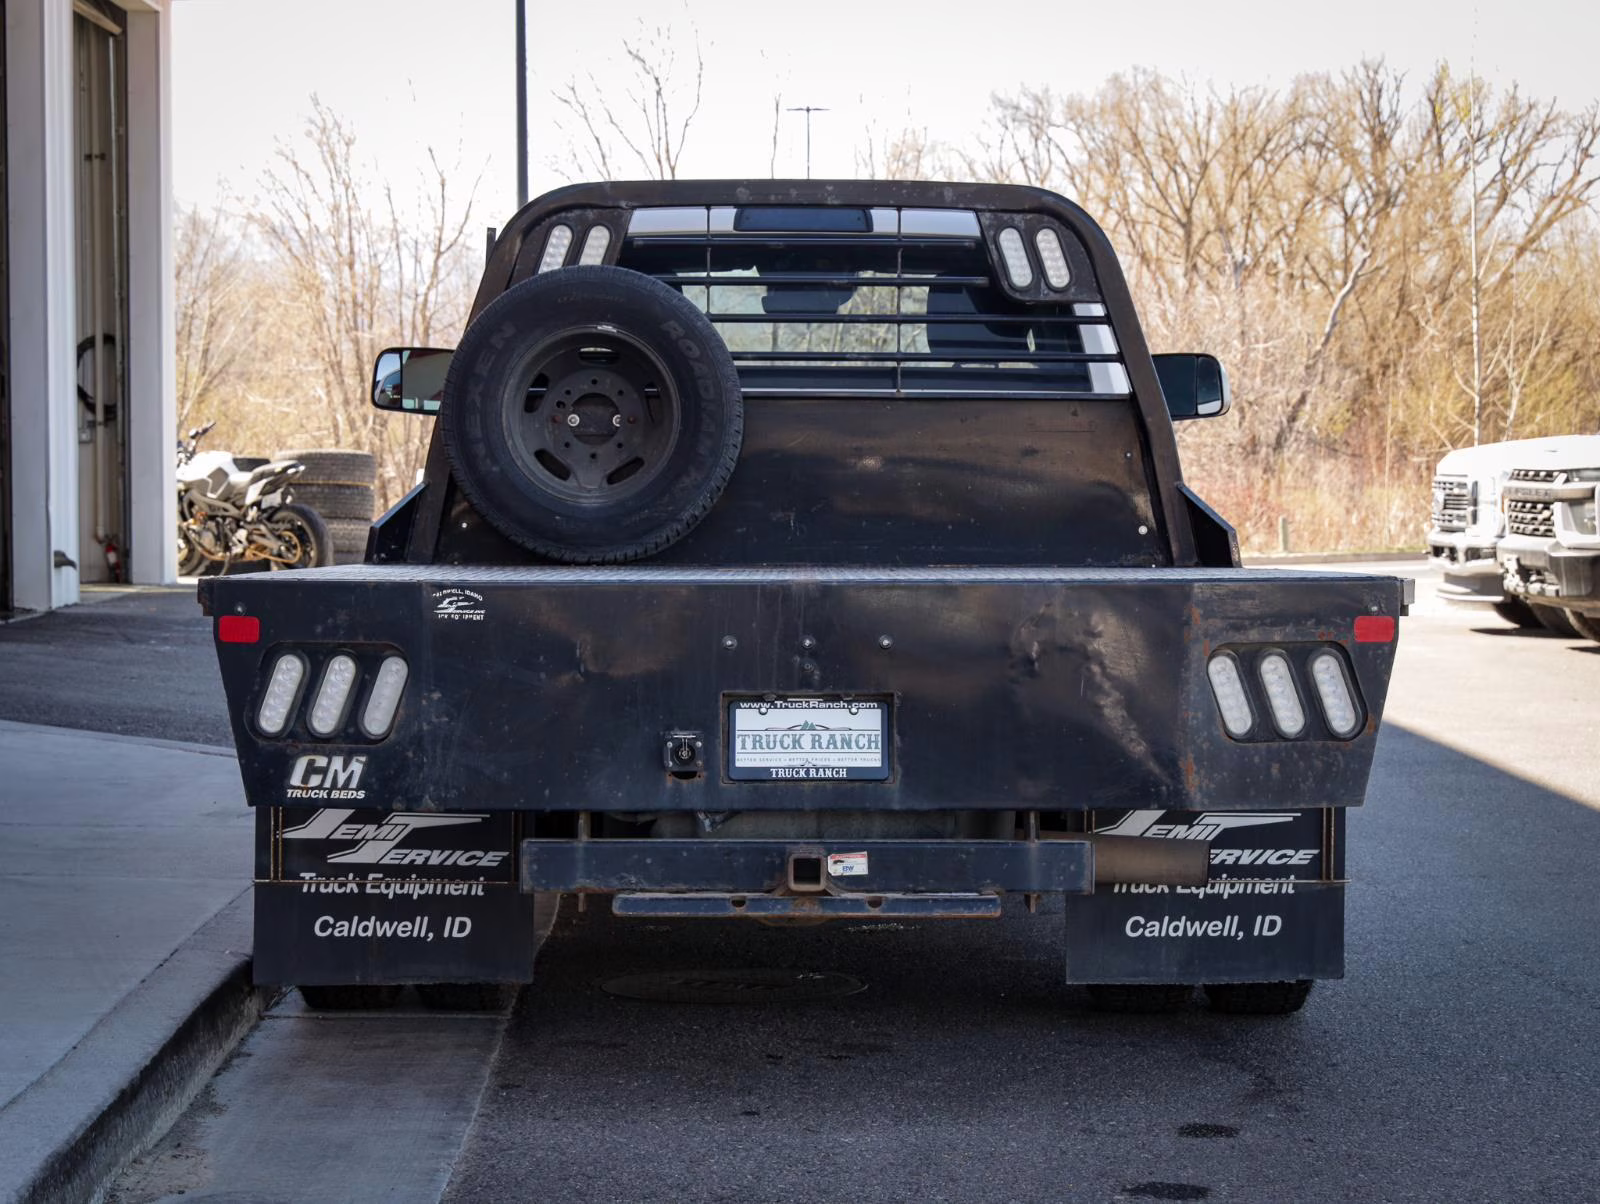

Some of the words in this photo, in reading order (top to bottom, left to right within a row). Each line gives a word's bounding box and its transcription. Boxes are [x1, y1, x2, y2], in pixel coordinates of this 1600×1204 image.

[739, 701, 878, 709] www.TruckRanch.com
[737, 733, 805, 751] TRUCK
[811, 733, 881, 751] RANCH
[289, 755, 367, 788] CM
[770, 768, 807, 778] TRUCK
[809, 768, 847, 778] RANCH
[287, 789, 329, 799] TRUCK
[330, 790, 366, 799] BEDS
[300, 872, 360, 894] Truck
[366, 873, 485, 900] Equipment
[314, 915, 434, 941] Caldwell,
[443, 916, 472, 938] ID
[1125, 915, 1244, 941] Caldwell,
[1253, 915, 1282, 937] ID
